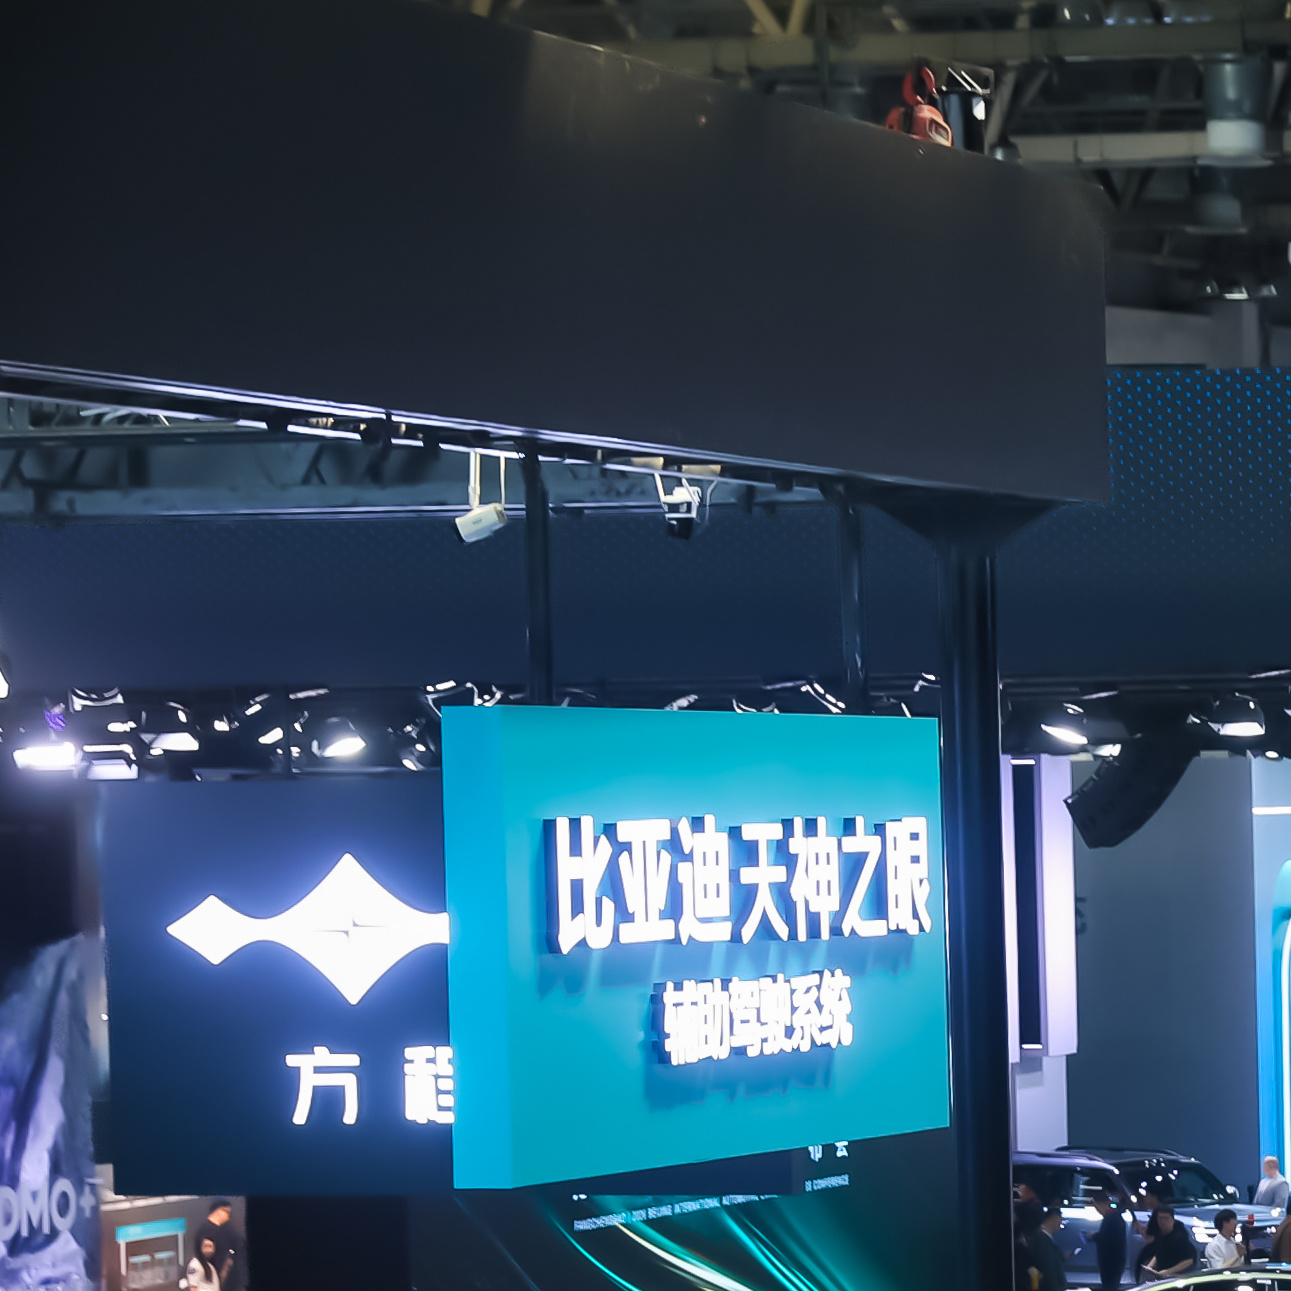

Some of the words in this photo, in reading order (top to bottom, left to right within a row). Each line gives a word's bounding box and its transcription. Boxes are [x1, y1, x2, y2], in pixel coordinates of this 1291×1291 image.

[555, 813, 932, 955] 比亚迪天神之眼
[662, 968, 854, 1066] 辅助驾驶系统
